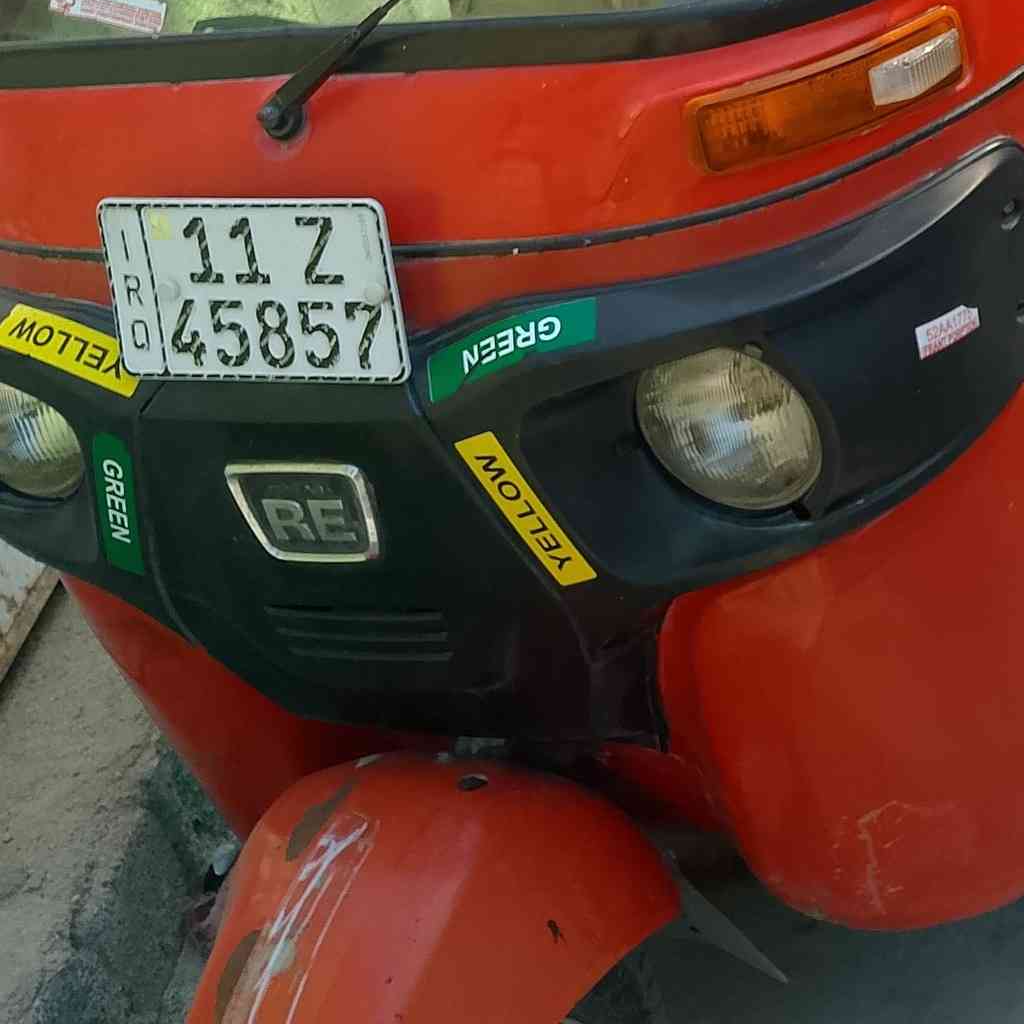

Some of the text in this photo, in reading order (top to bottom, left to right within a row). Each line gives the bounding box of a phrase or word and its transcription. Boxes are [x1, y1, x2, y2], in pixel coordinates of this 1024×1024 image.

[182, 216, 272, 285] 11
[295, 216, 345, 285] Z
[8, 317, 123, 379] YELLOW
[171, 299, 383, 370] 45857
[462, 316, 561, 376] GREEN
[102, 458, 131, 544] GREEN
[261, 498, 359, 542] RE
[474, 455, 572, 570] YELLOW
